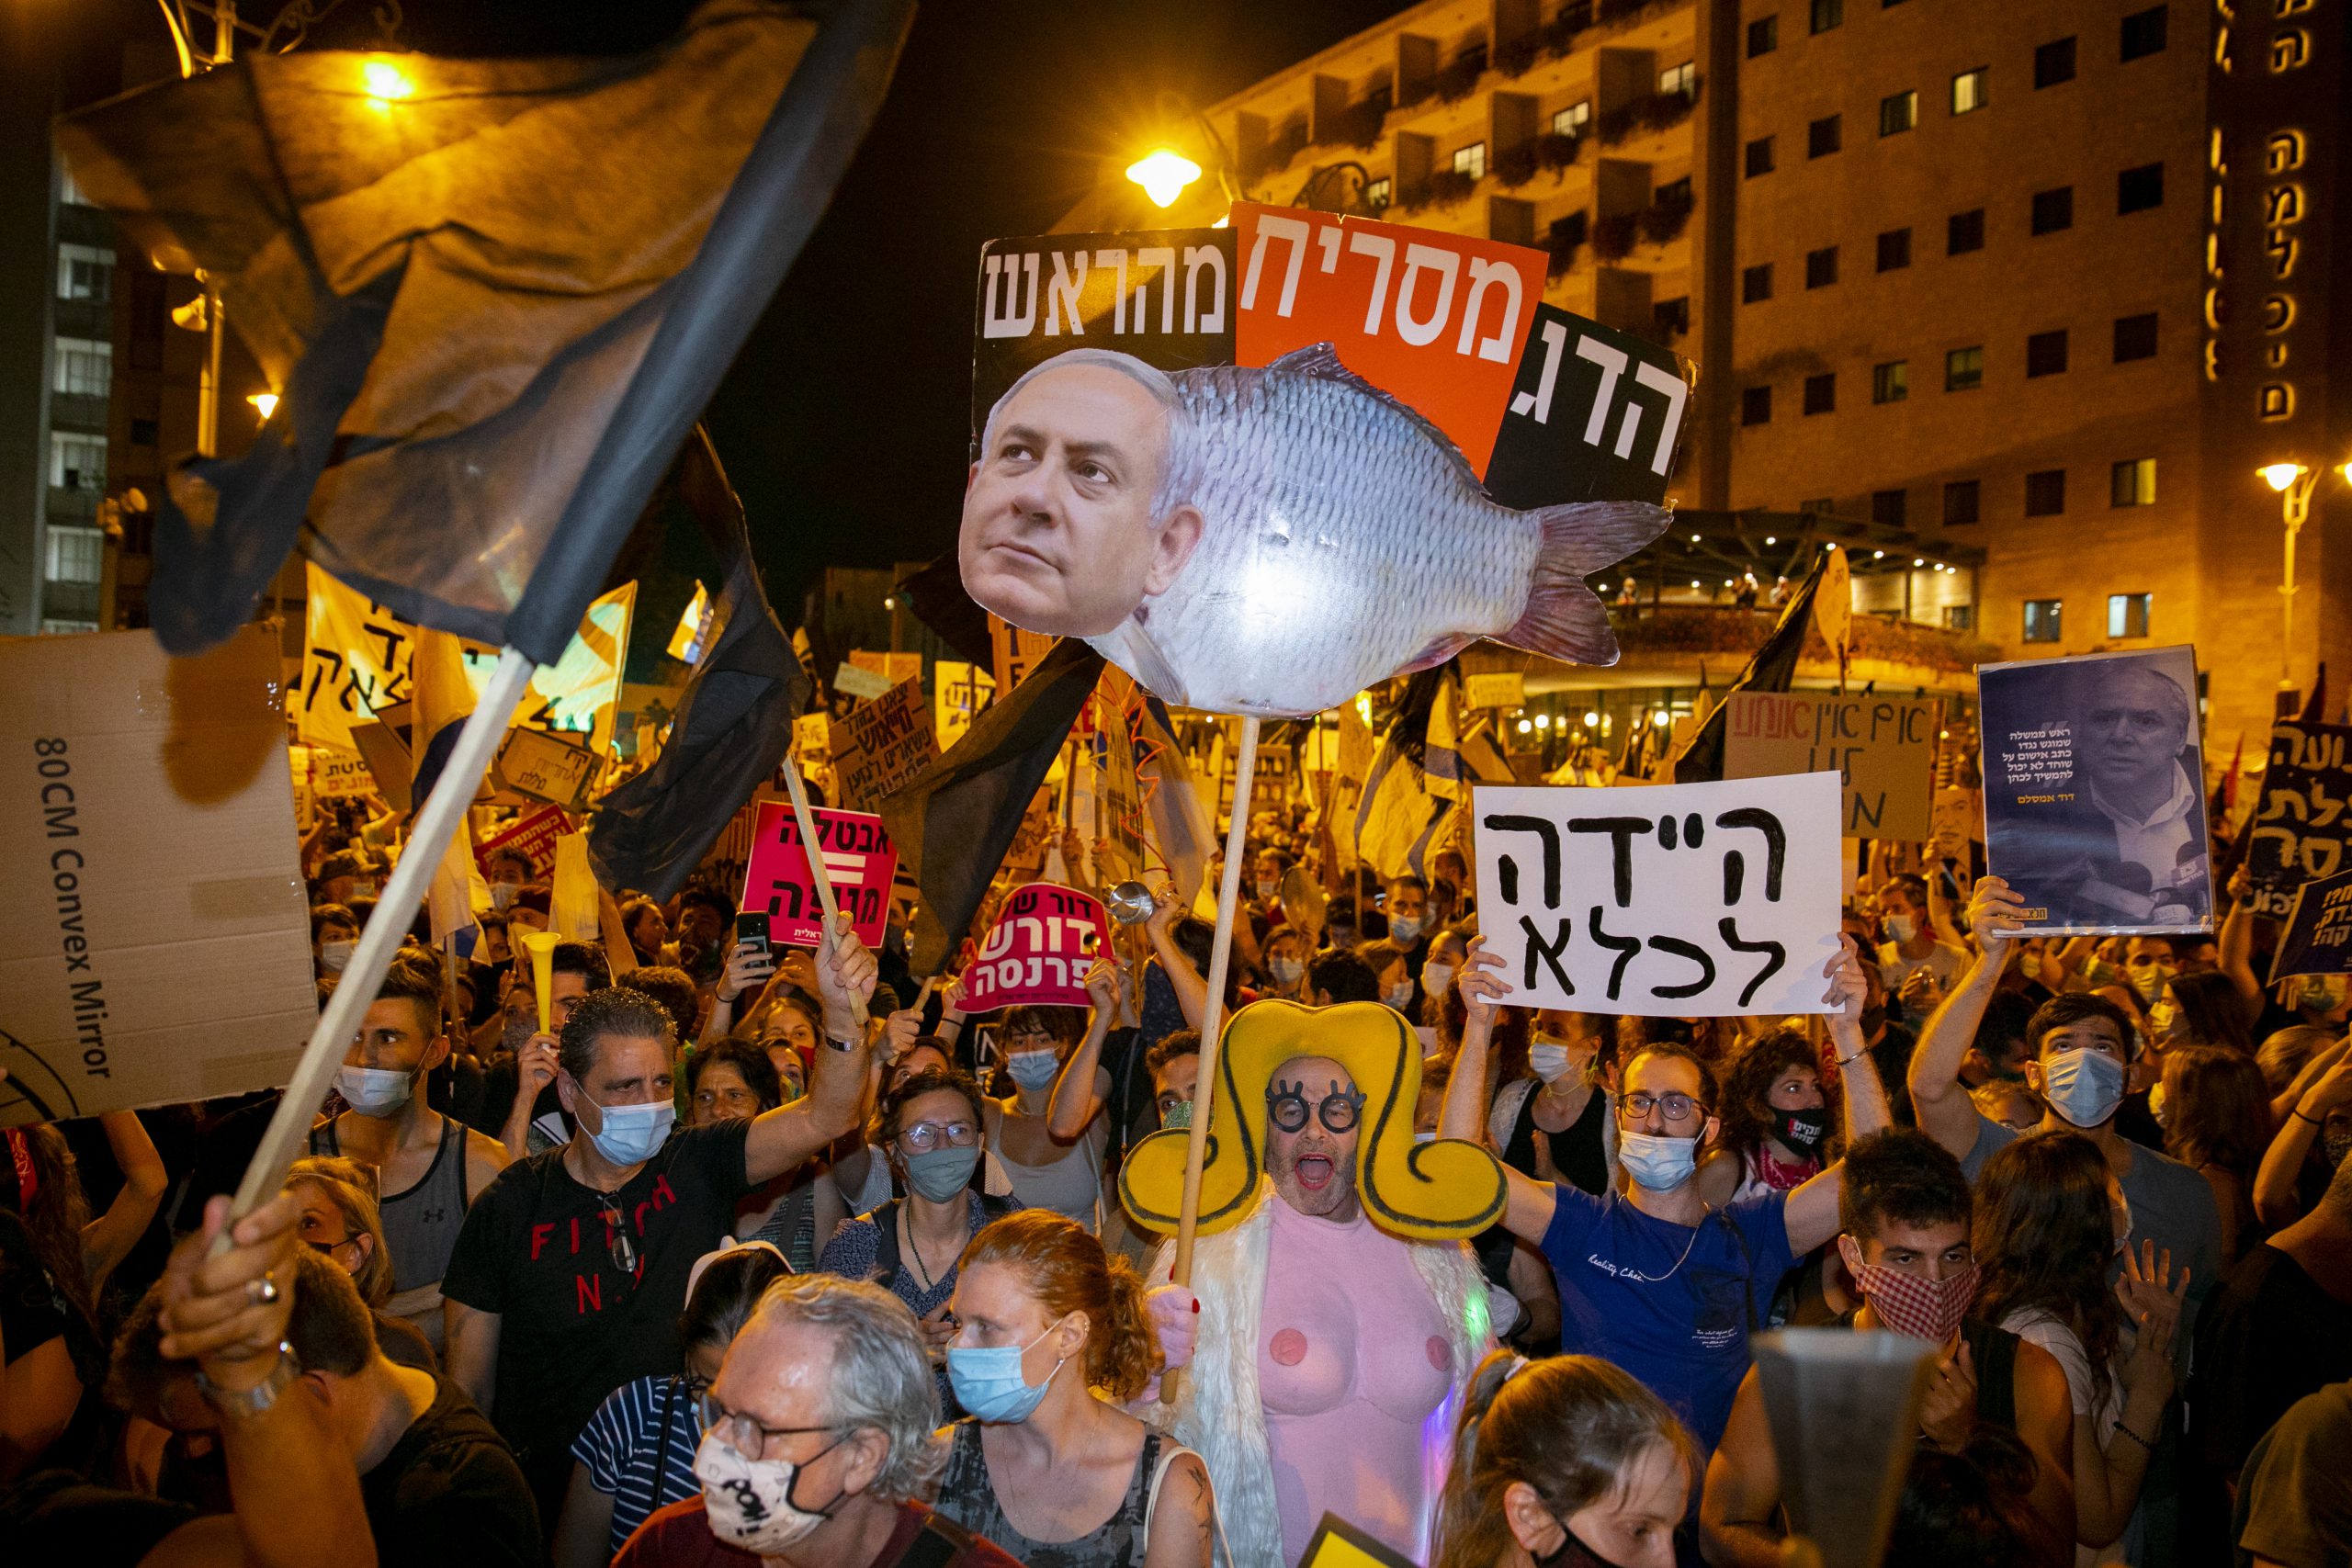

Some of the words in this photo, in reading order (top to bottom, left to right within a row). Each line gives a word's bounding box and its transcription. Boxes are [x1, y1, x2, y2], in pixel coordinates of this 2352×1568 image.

[982, 243, 1227, 340] מהראש
[1241, 213, 1524, 366] מסריח
[1509, 319, 1690, 479] הדג
[2009, 730, 2046, 740] ממשלה
[2048, 728, 2071, 738] ראש
[2018, 741, 2037, 750] נגדו
[2040, 739, 2072, 749] שמוגש
[2002, 752, 2015, 762] על
[2018, 750, 2049, 761] אישום
[2051, 750, 2073, 759] כתב
[2007, 762, 2027, 773] יכול
[2030, 761, 2044, 771] לא
[2046, 760, 2073, 769] שוחד
[2007, 772, 2031, 784] לכהן
[2033, 769, 2074, 783] להמשיך
[34, 736, 80, 839] 80CM
[2017, 795, 2055, 805] אמסלם
[2057, 793, 2075, 802] דוד
[1483, 807, 1787, 910] היידה
[51, 847, 92, 974] Convex
[1048, 892, 1092, 919] דור
[978, 916, 1097, 961] דורש
[1518, 905, 1787, 1008] לכלא
[975, 956, 1095, 997] פרנסה
[70, 979, 111, 1080] Mirror
[530, 1174, 677, 1261] FITCH
[1587, 1253, 1617, 1278] Reality
